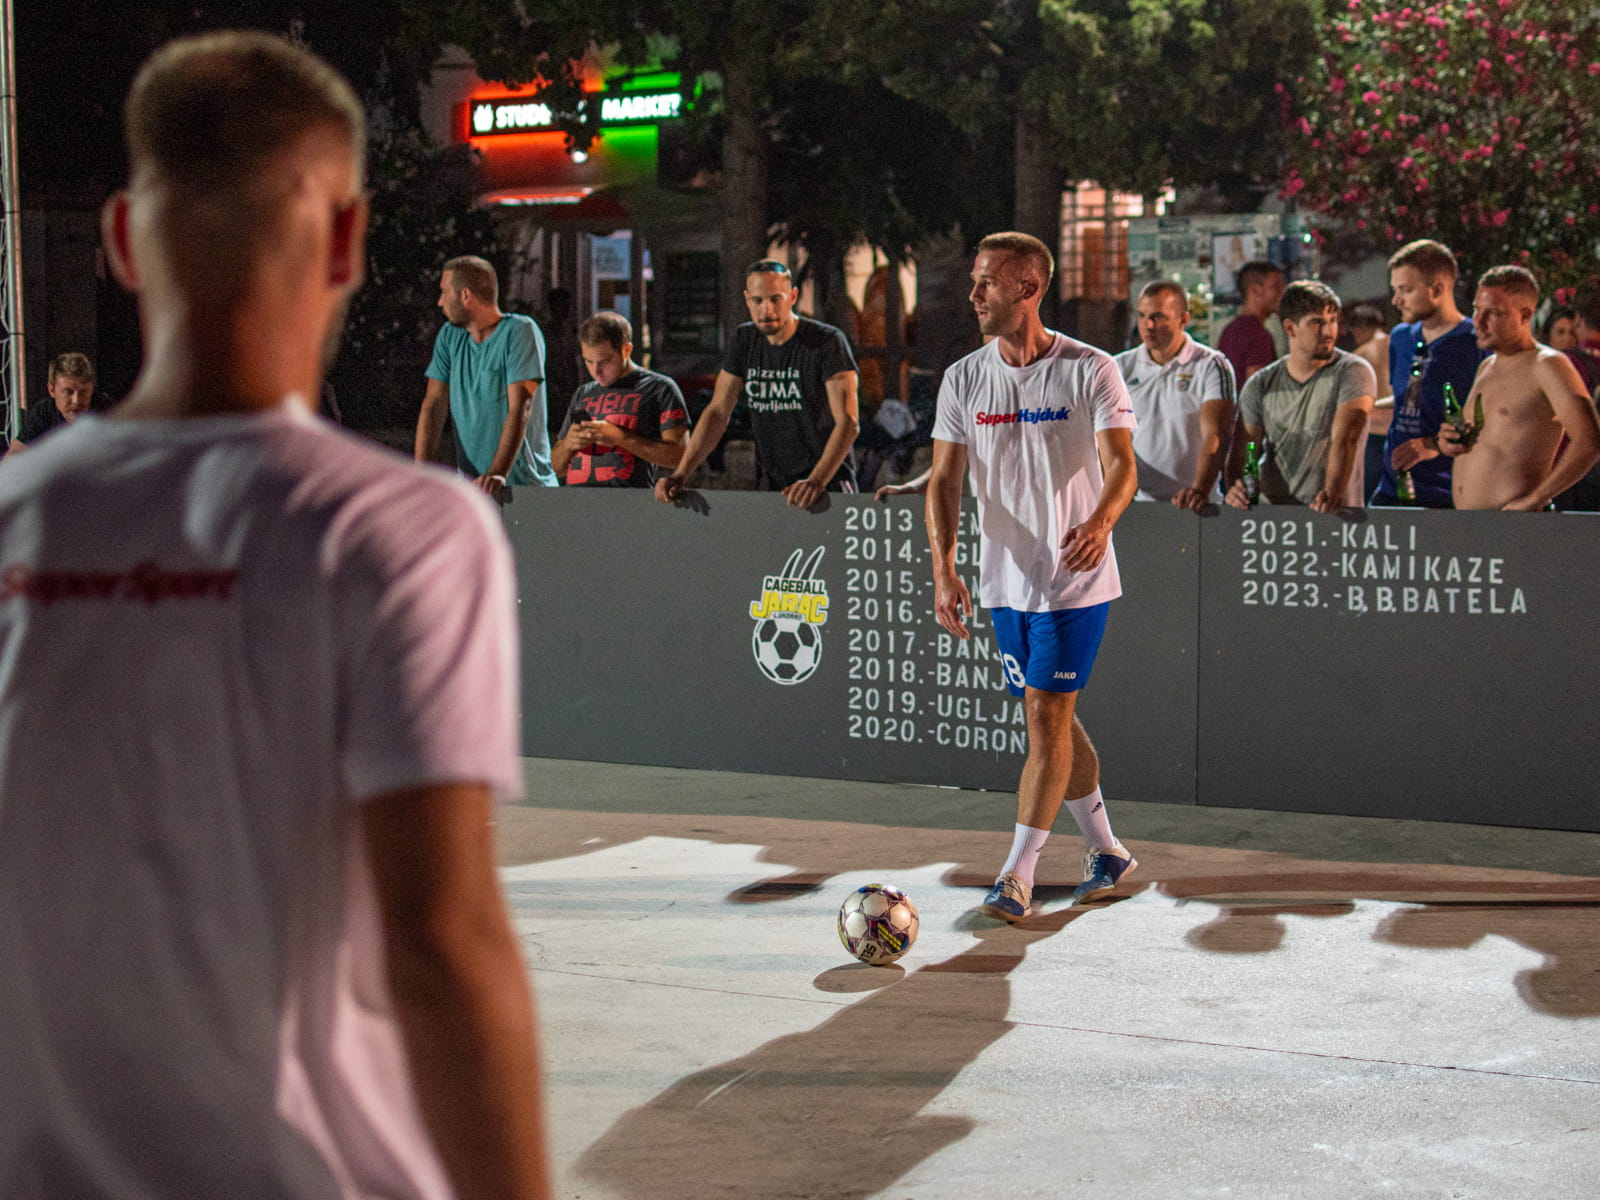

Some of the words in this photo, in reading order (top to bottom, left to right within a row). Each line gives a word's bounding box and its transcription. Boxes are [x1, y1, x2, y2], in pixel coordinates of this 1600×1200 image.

[601, 93, 682, 120] MARKET
[745, 380, 801, 399] CIMA
[976, 406, 1070, 427] SuperHajduk
[764, 577, 825, 595] CAGEBALL
[751, 591, 828, 624] JARAC
[999, 650, 1026, 688] 8
[1053, 671, 1077, 680] JAKO
